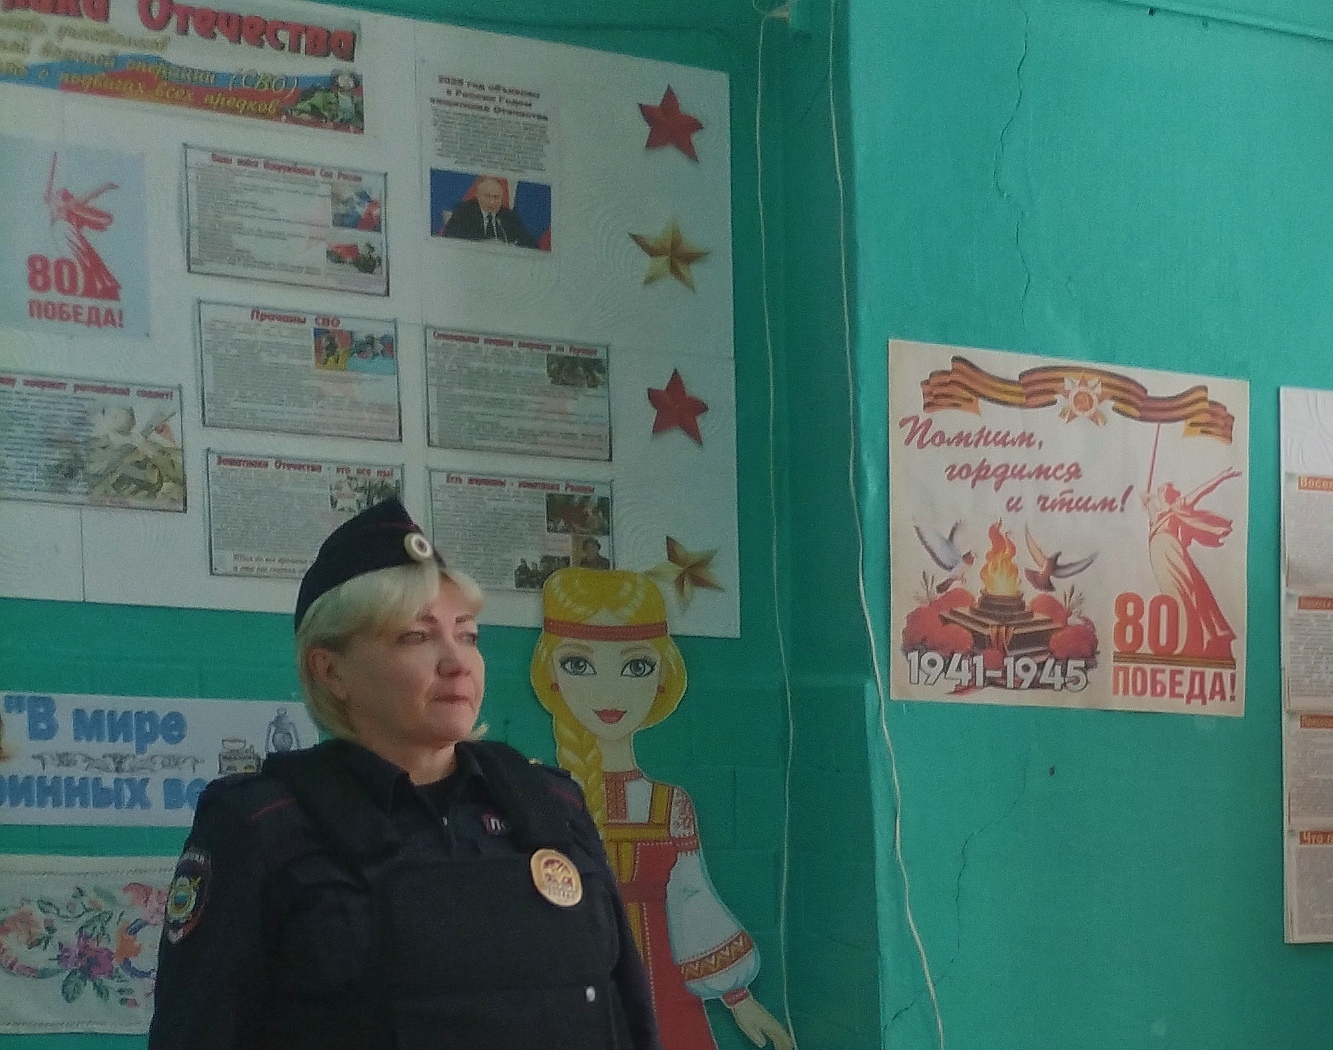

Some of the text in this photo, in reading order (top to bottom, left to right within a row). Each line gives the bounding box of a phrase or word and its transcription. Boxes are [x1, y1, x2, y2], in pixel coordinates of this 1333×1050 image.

[138, 0, 357, 62] Отечества
[27, 252, 79, 297] 80
[27, 298, 124, 329] ПОБЕДА!
[899, 415, 1044, 450] Помним,
[944, 457, 1083, 490] гордимся
[1005, 484, 1136, 514] и чтим!
[1112, 591, 1180, 656] 80
[905, 649, 1091, 693] 1941-1945
[1111, 664, 1238, 706] ПОБЕДА!
[4, 695, 188, 755] "В мире
[1302, 831, 1323, 845] Что
